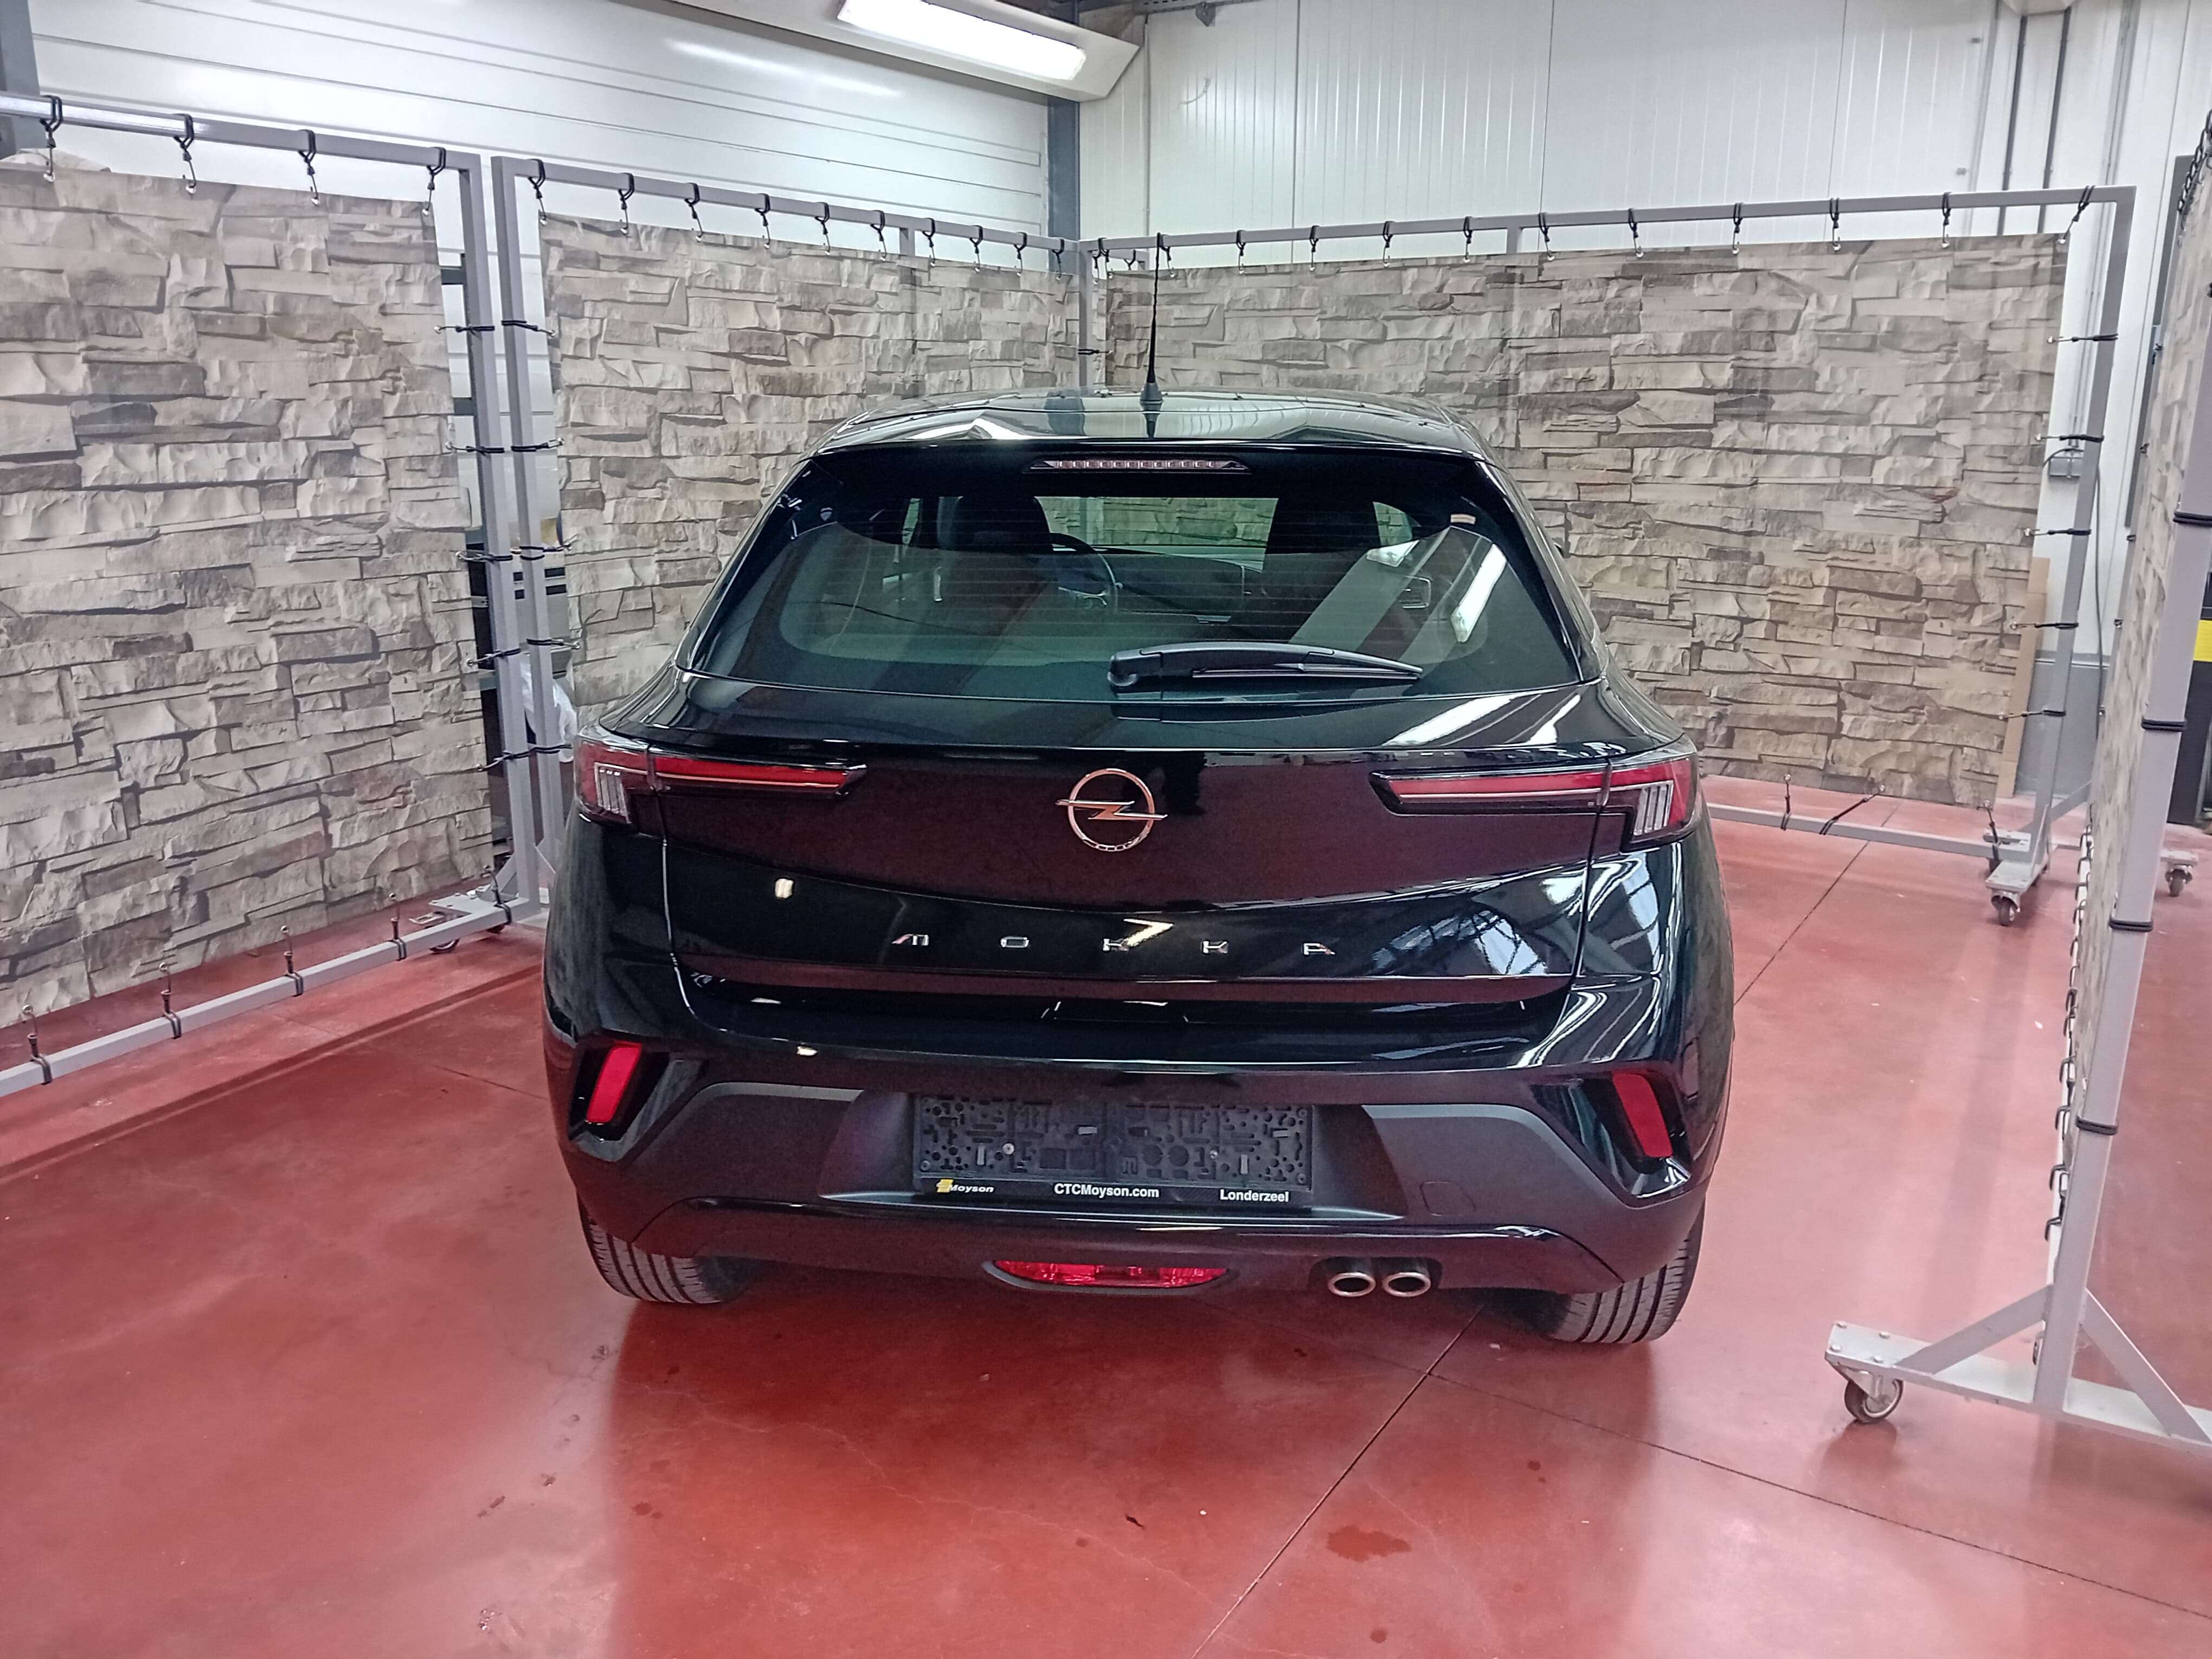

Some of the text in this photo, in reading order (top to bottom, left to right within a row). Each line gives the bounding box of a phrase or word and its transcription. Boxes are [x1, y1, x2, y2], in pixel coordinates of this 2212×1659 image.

[891, 934, 1335, 955] MOKKA
[949, 1184, 994, 1193] Moyson
[1054, 1183, 1160, 1199] CTCMoyson.com
[1220, 1188, 1290, 1203] Londerzeel
